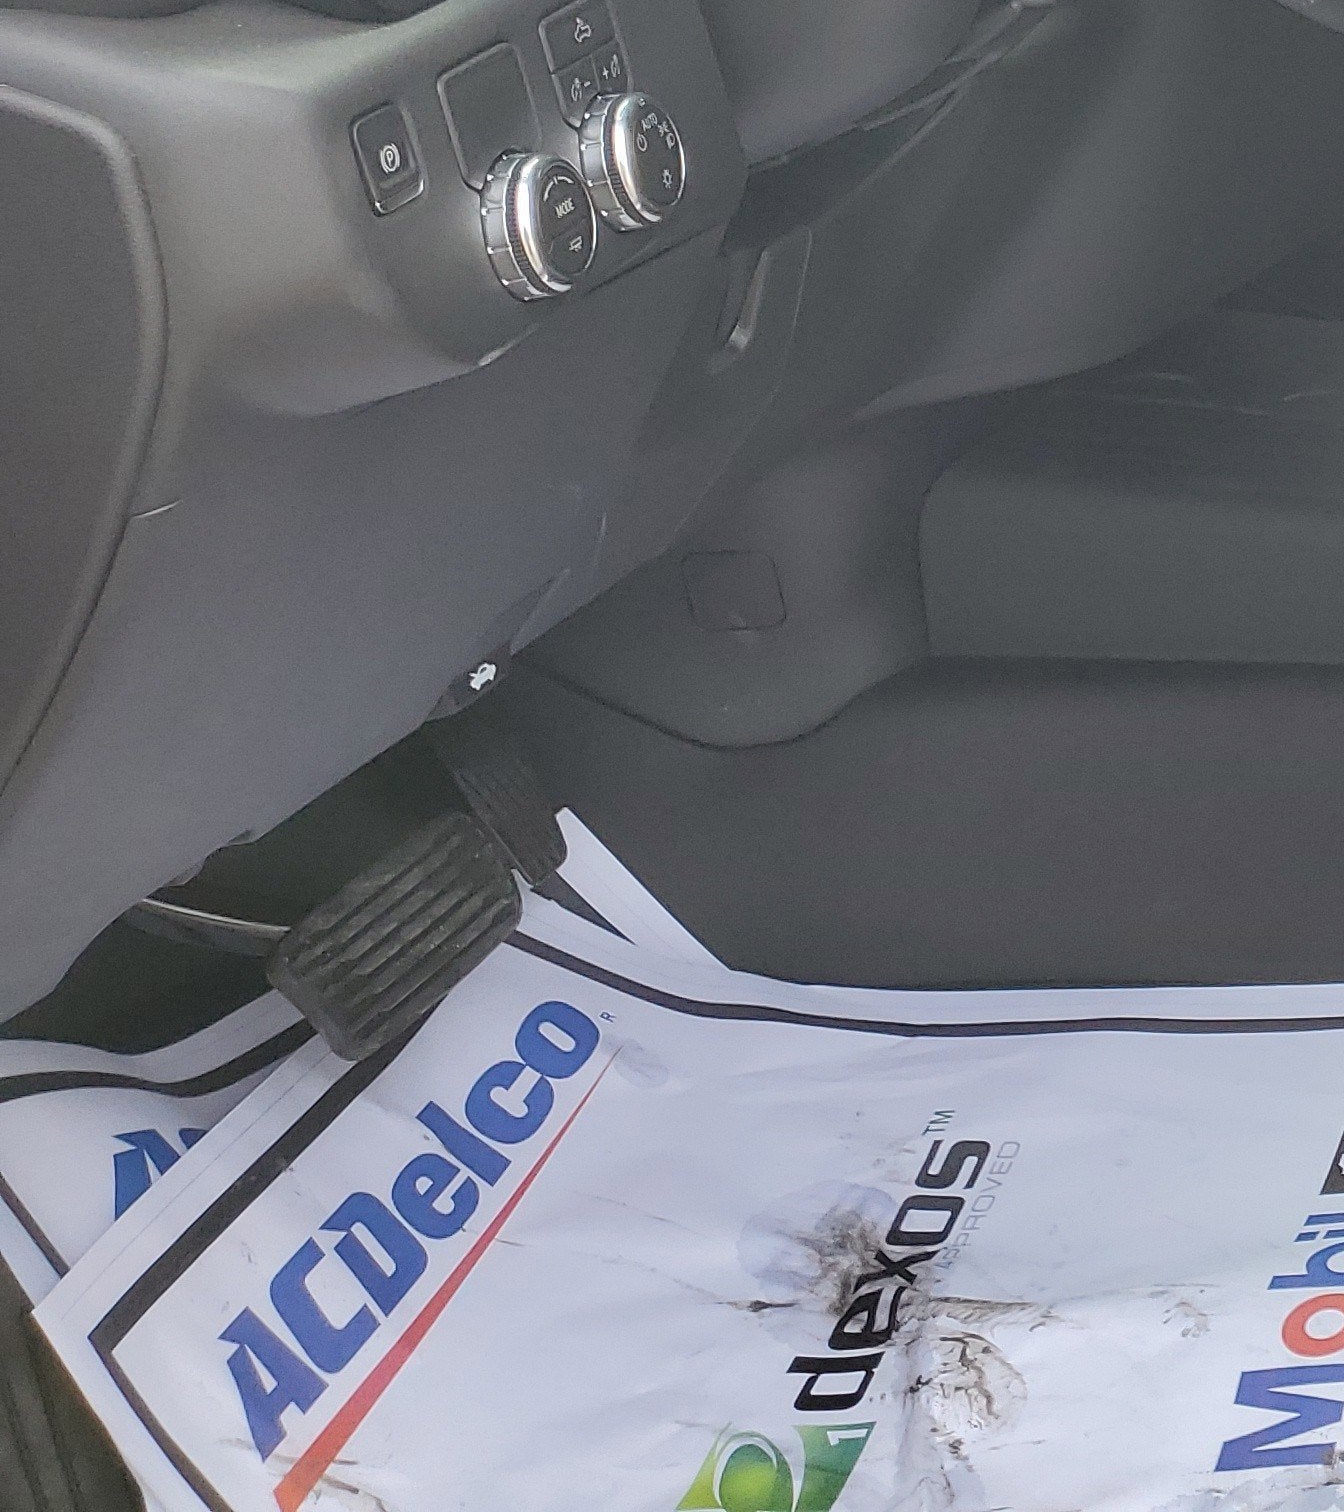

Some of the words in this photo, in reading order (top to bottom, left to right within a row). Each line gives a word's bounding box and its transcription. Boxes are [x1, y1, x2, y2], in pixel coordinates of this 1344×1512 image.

[641, 112, 658, 133] AUTO
[553, 197, 576, 219] MODE
[217, 1000, 601, 1464] ACDelco
[786, 1139, 991, 1412] dexos
